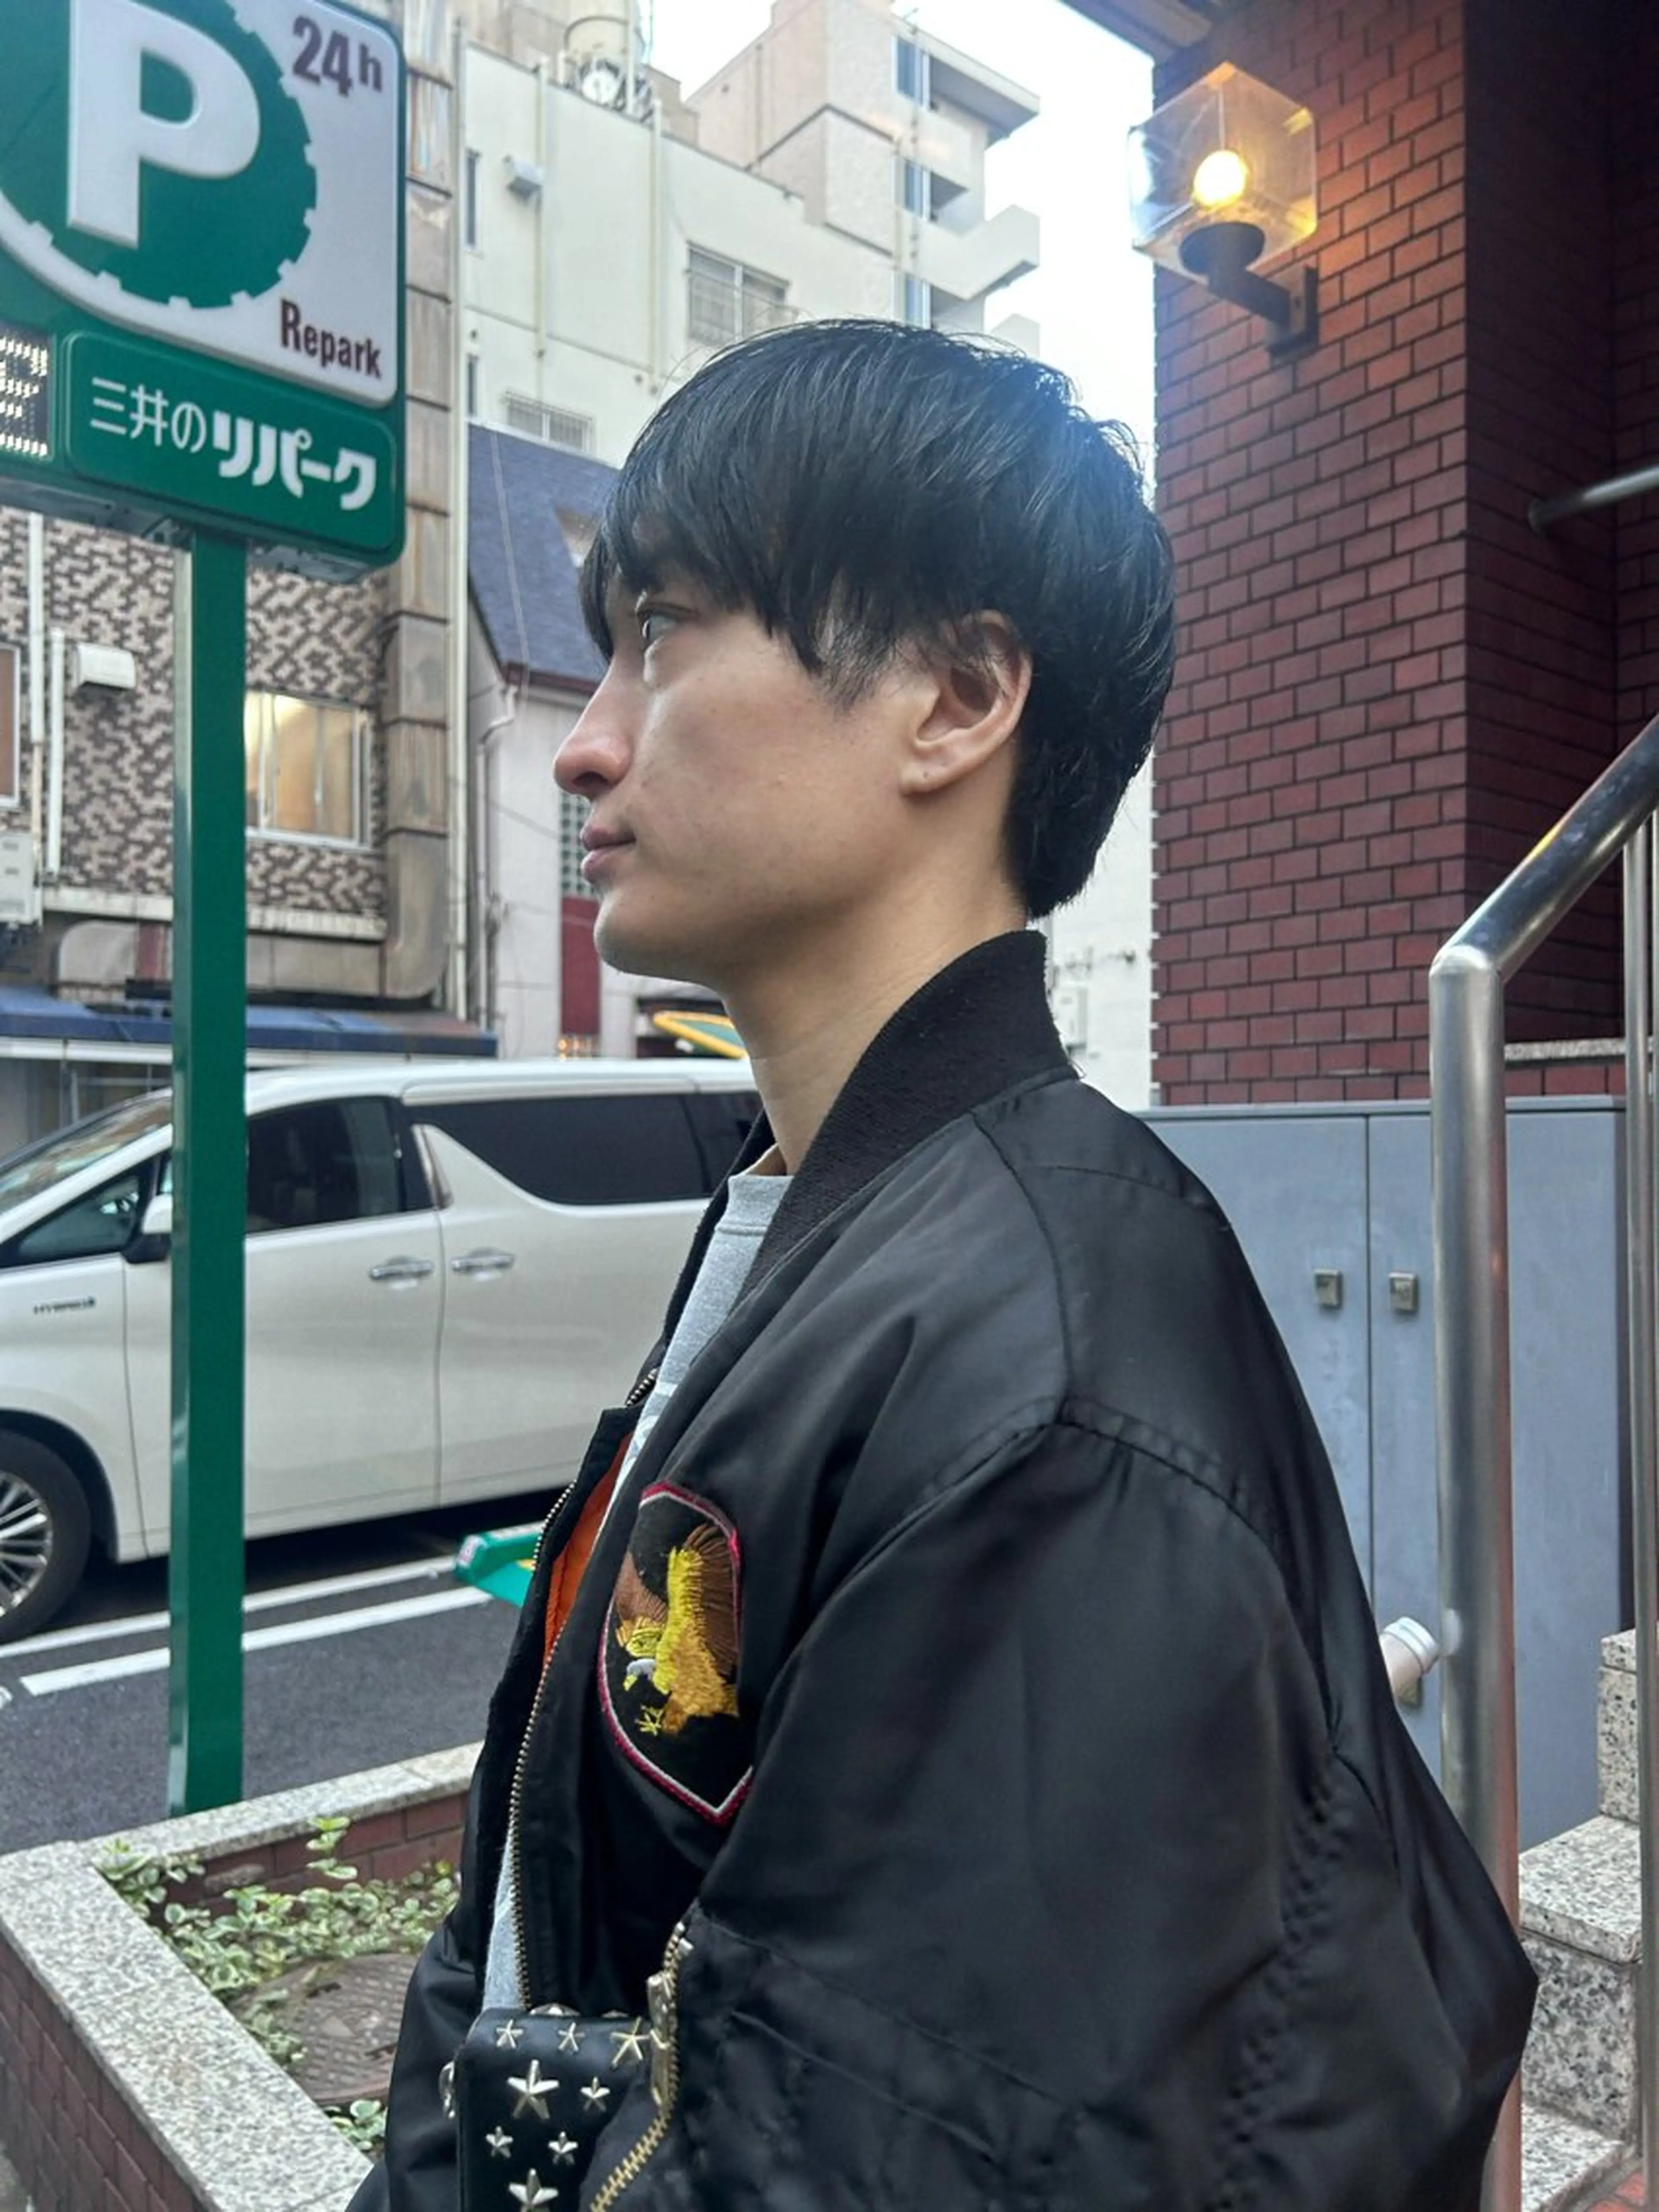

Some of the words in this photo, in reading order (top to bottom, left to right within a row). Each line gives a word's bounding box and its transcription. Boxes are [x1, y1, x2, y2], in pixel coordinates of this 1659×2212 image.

[292, 14, 383, 98] 24h
[67, 0, 260, 250] P
[280, 298, 382, 380] Repark
[90, 377, 376, 511] 三井のリパーク
